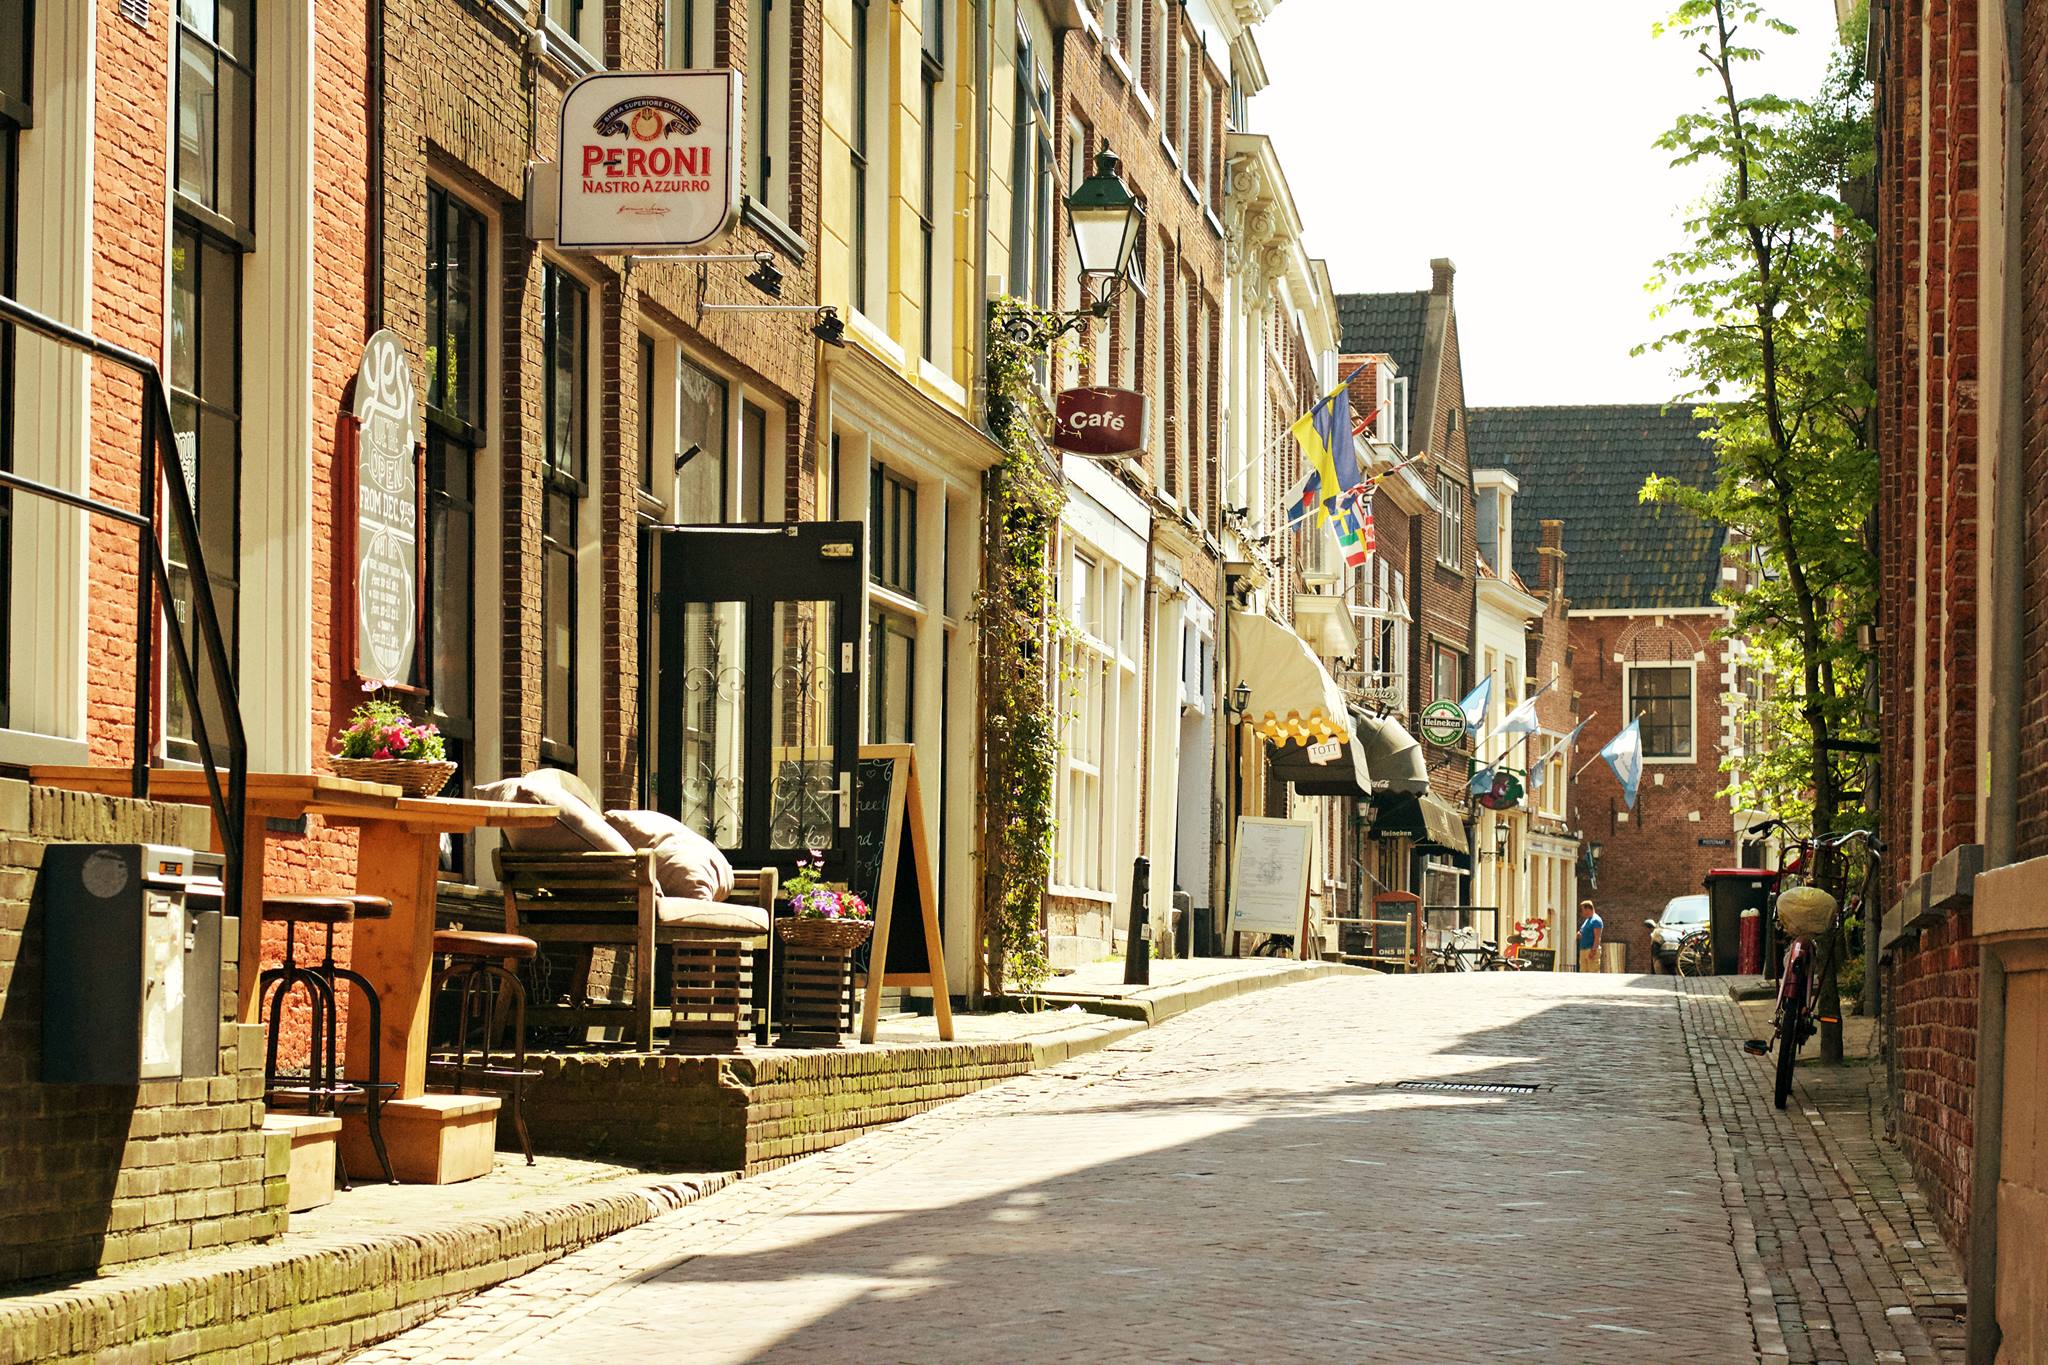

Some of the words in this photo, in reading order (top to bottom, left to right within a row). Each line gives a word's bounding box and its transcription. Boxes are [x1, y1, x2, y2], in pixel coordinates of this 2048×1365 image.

[603, 107, 625, 122] BIRRA
[625, 100, 662, 110] SUPERIORE
[664, 102, 690, 121] D'ITALIA
[581, 145, 712, 178] PERONI
[582, 180, 640, 193] NASTRO
[642, 179, 710, 193] AZZURRO
[1069, 411, 1125, 431] Café
[370, 449, 404, 490] OPEN
[359, 484, 382, 515] FROM
[1424, 718, 1461, 728] Heineken
[1311, 743, 1337, 756] TOTT
[1381, 830, 1413, 838] Heineken
